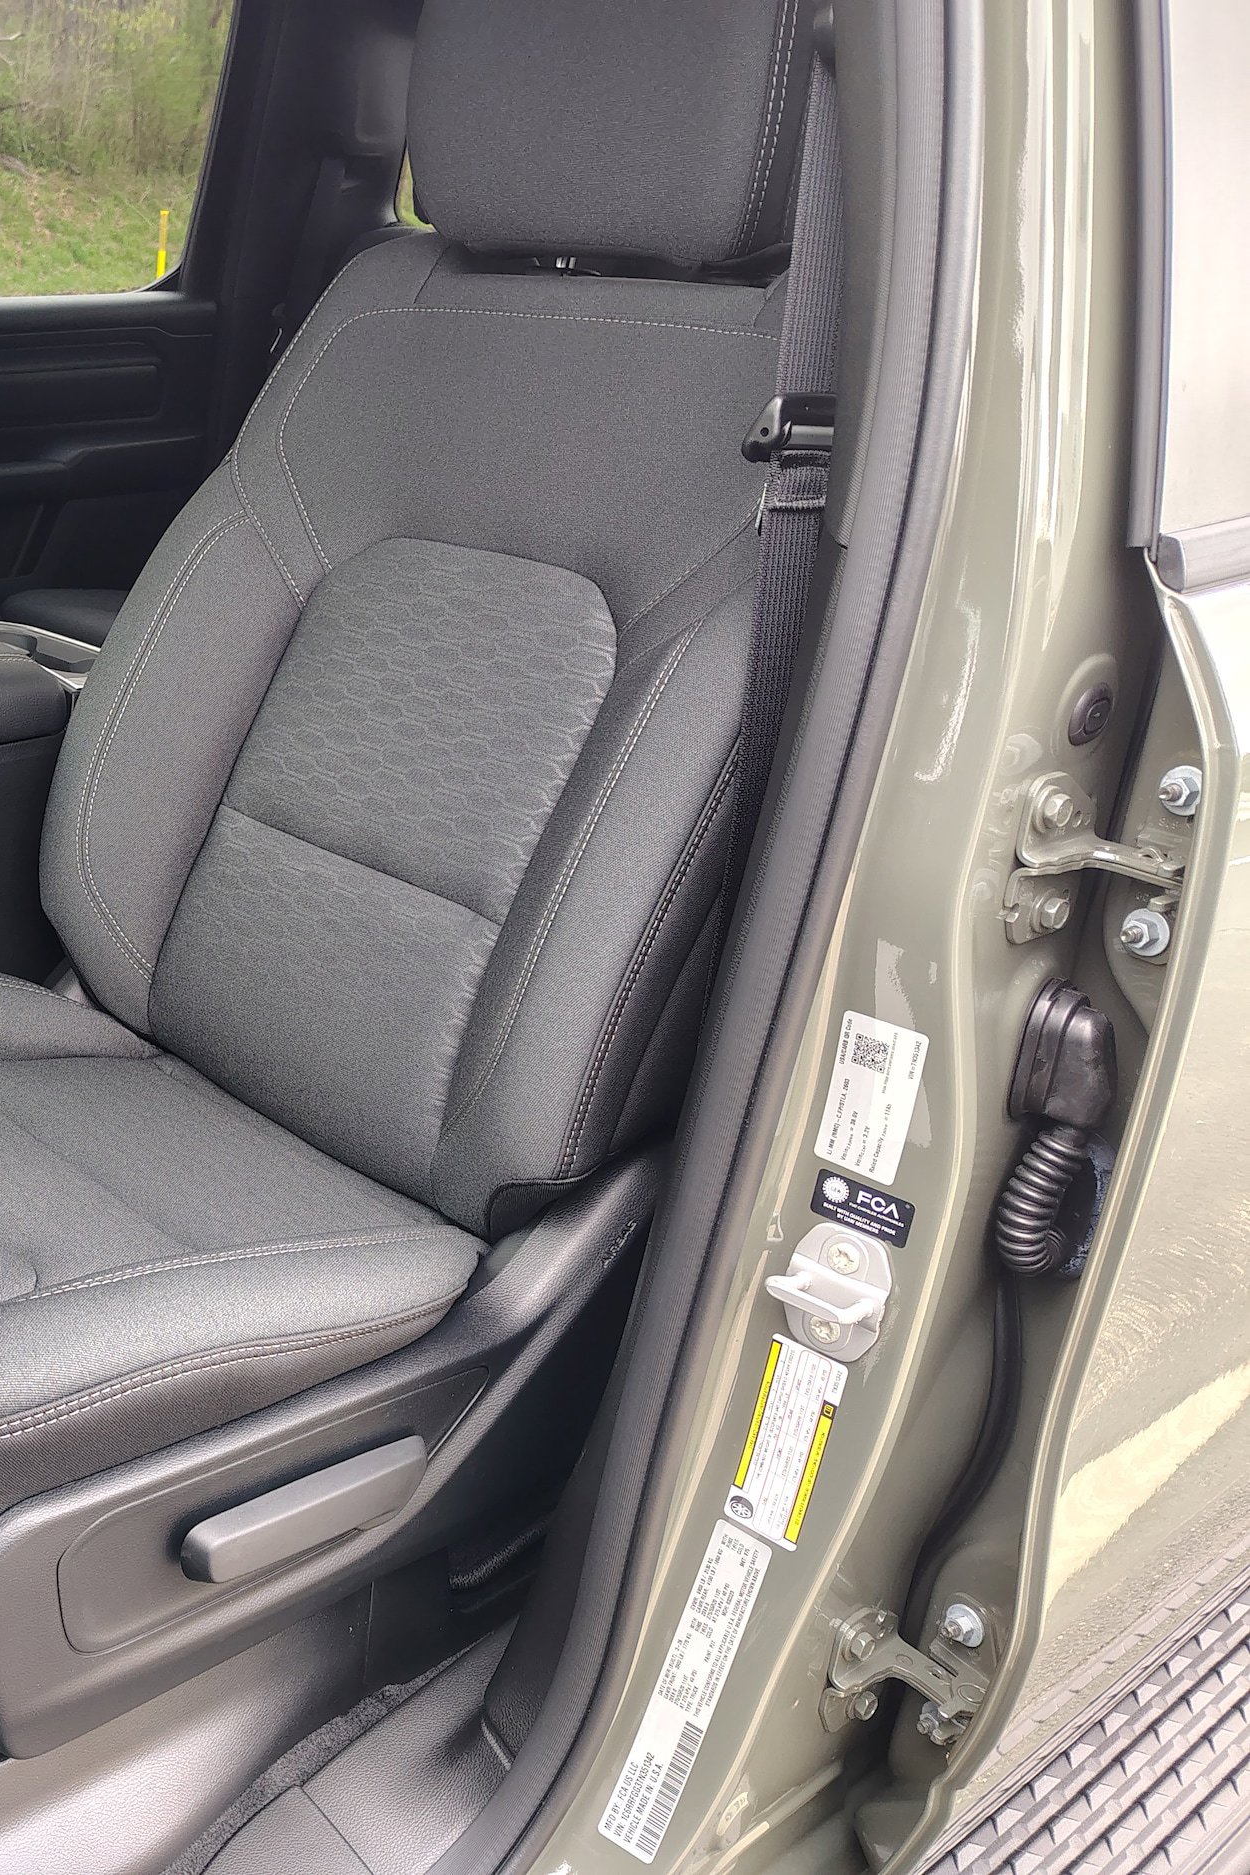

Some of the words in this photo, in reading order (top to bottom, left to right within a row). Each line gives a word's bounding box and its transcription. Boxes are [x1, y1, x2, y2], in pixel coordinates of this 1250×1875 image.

[844, 1017, 853, 1031] Code
[872, 1136, 884, 1158] Capacity
[855, 1189, 902, 1220] FCA
[822, 1201, 836, 1211] BUILT
[836, 1206, 850, 1217] WITH
[848, 1212, 870, 1225] QUALITY
[869, 1220, 881, 1229] AND
[880, 1225, 896, 1236] PRIDE
[836, 1212, 843, 1220] BY
[842, 1215, 855, 1224] UAW
[854, 1220, 879, 1234] MEMBERS
[600, 1219, 638, 1269] AIRBAG
[713, 1652, 721, 1663] ALL
[742, 1564, 754, 1584] VEHICLE
[748, 1548, 760, 1566] SAFETY
[627, 1760, 639, 1776] LLC
[648, 1759, 664, 1784] U.S.A.
[622, 1773, 633, 1787] US
[643, 1781, 655, 1795] IN:
[616, 1784, 629, 1801] FCA
[635, 1792, 650, 1816] MADE
[603, 1812, 616, 1832] MFD
[613, 1820, 626, 1838] VIN:
[622, 1812, 641, 1845] VEHICLE
